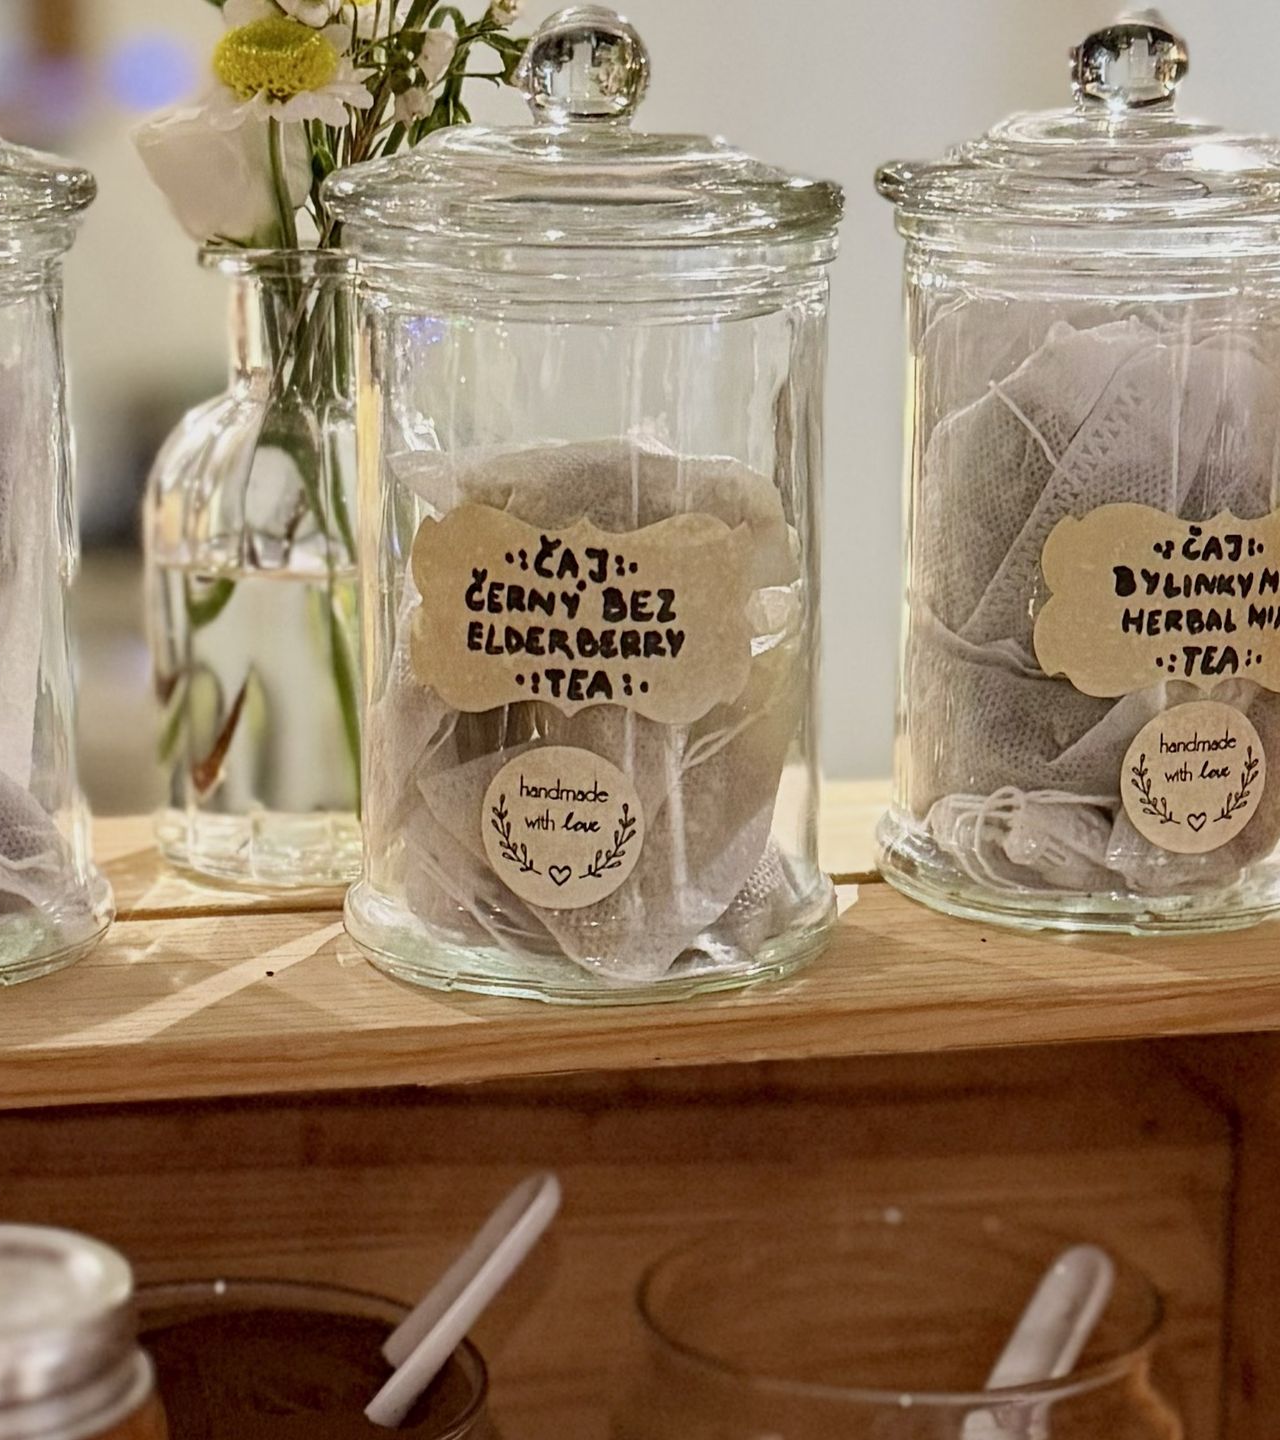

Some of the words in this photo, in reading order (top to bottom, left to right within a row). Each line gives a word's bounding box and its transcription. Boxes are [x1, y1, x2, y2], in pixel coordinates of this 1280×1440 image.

[1112, 566, 1255, 598] BYLINKY
[601, 587, 677, 623] BEZ
[1121, 606, 1239, 637] HERBAL
[466, 621, 686, 660] ELDERBERRY
[1159, 729, 1238, 755] handmade
[1164, 764, 1194, 783] with
[1197, 762, 1232, 781] love
[519, 774, 610, 804] handmade
[524, 814, 556, 833] with
[561, 813, 602, 834] love
